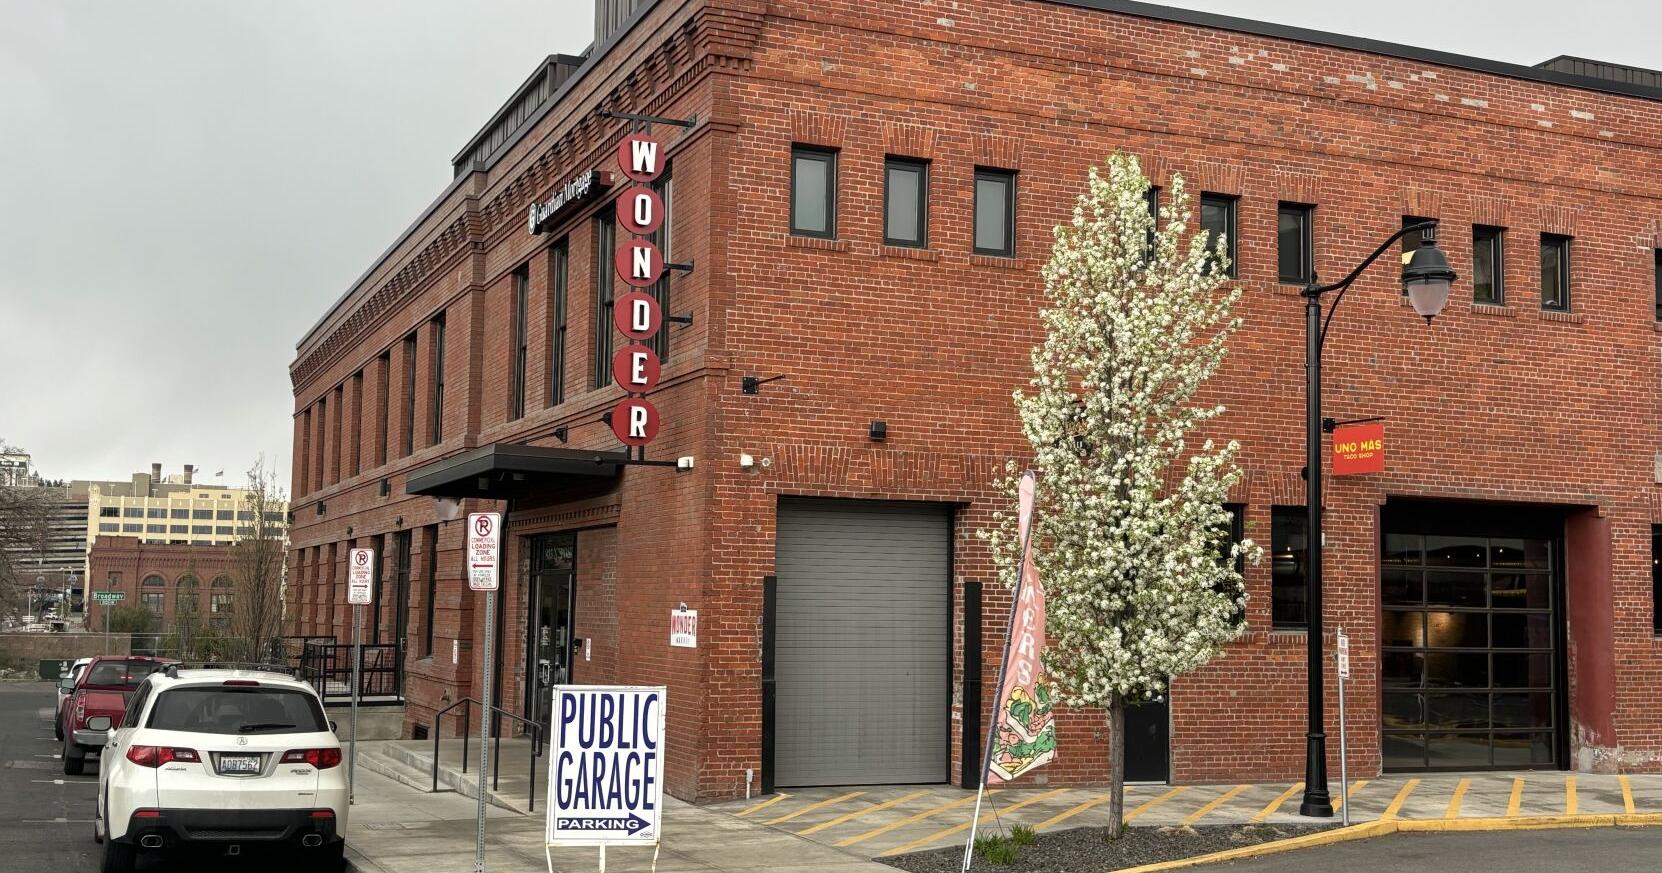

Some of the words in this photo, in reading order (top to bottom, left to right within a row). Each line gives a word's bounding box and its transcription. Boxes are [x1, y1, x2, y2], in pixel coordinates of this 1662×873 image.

[536, 191, 565, 225] Guardian
[564, 169, 592, 201] Mortgage
[628, 140, 658, 438] WONDER
[1335, 442, 1357, 454] UNO
[93, 592, 124, 600] Broadway
[671, 615, 696, 637] WONDER
[560, 693, 658, 750] PUBLIC
[557, 751, 656, 810] GARAGE
[558, 819, 640, 829] PARKING
